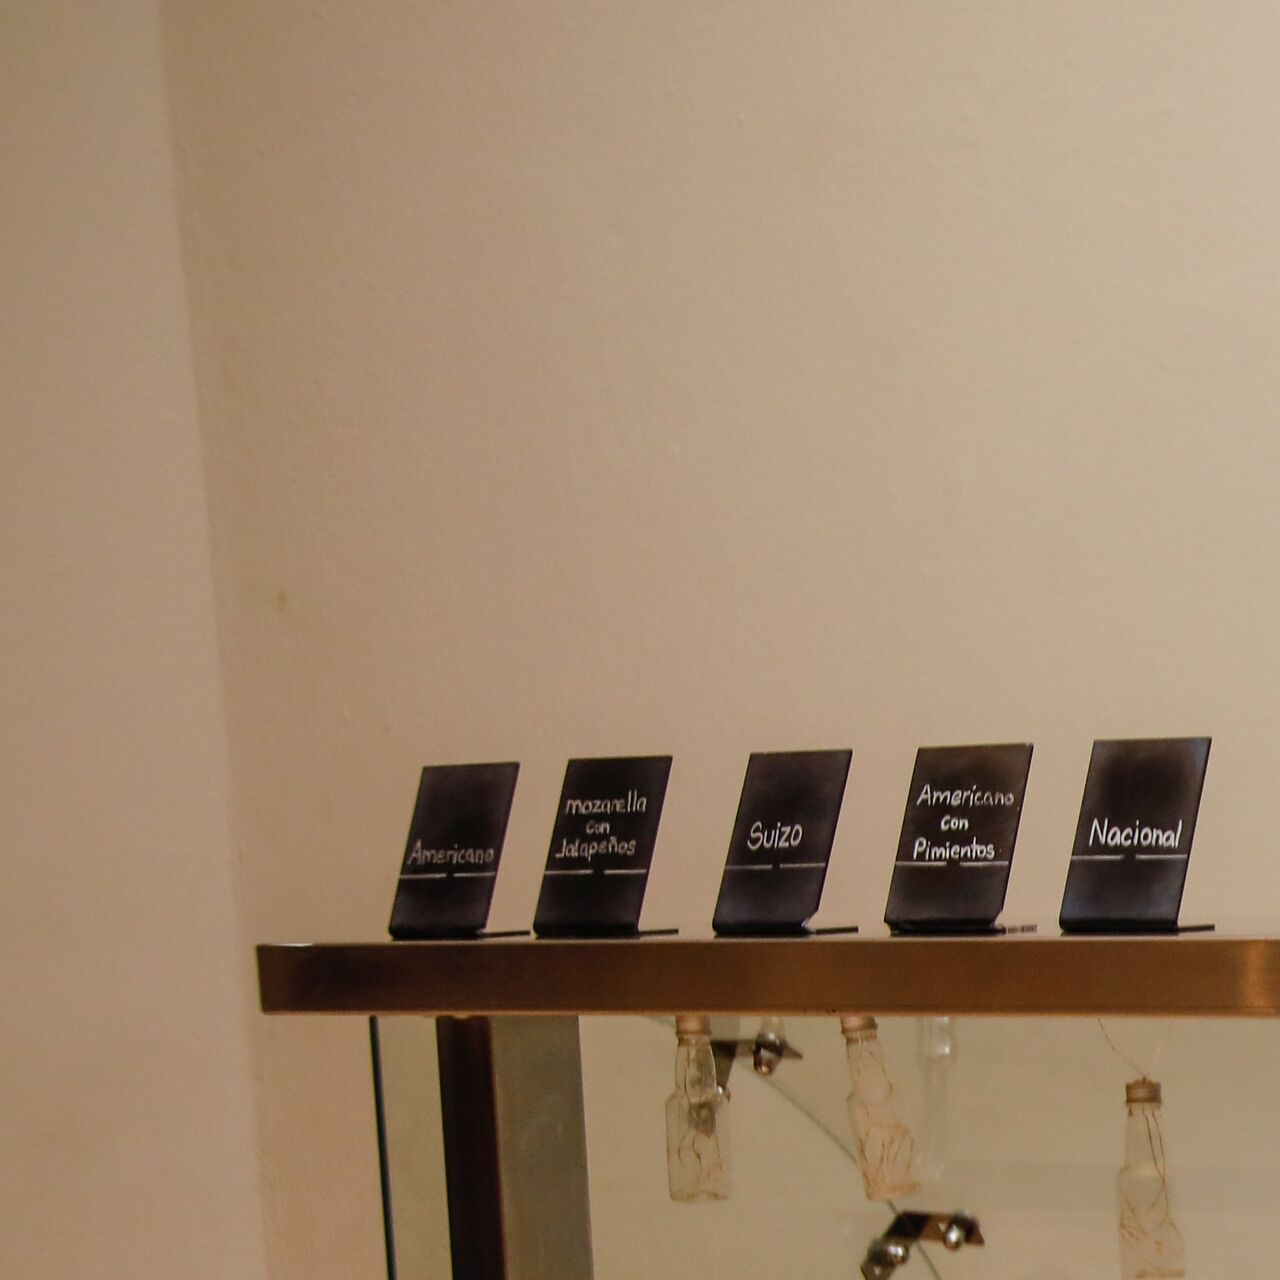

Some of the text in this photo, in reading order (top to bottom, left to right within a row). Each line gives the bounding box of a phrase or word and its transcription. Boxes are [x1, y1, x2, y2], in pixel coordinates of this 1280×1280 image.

[916, 783, 1015, 807] Americano
[747, 821, 803, 850] Suizo
[1088, 817, 1183, 848] Nacional
[407, 839, 495, 865] Americano
[555, 836, 637, 862] Jalapeños
[912, 836, 996, 861] Pimientos
